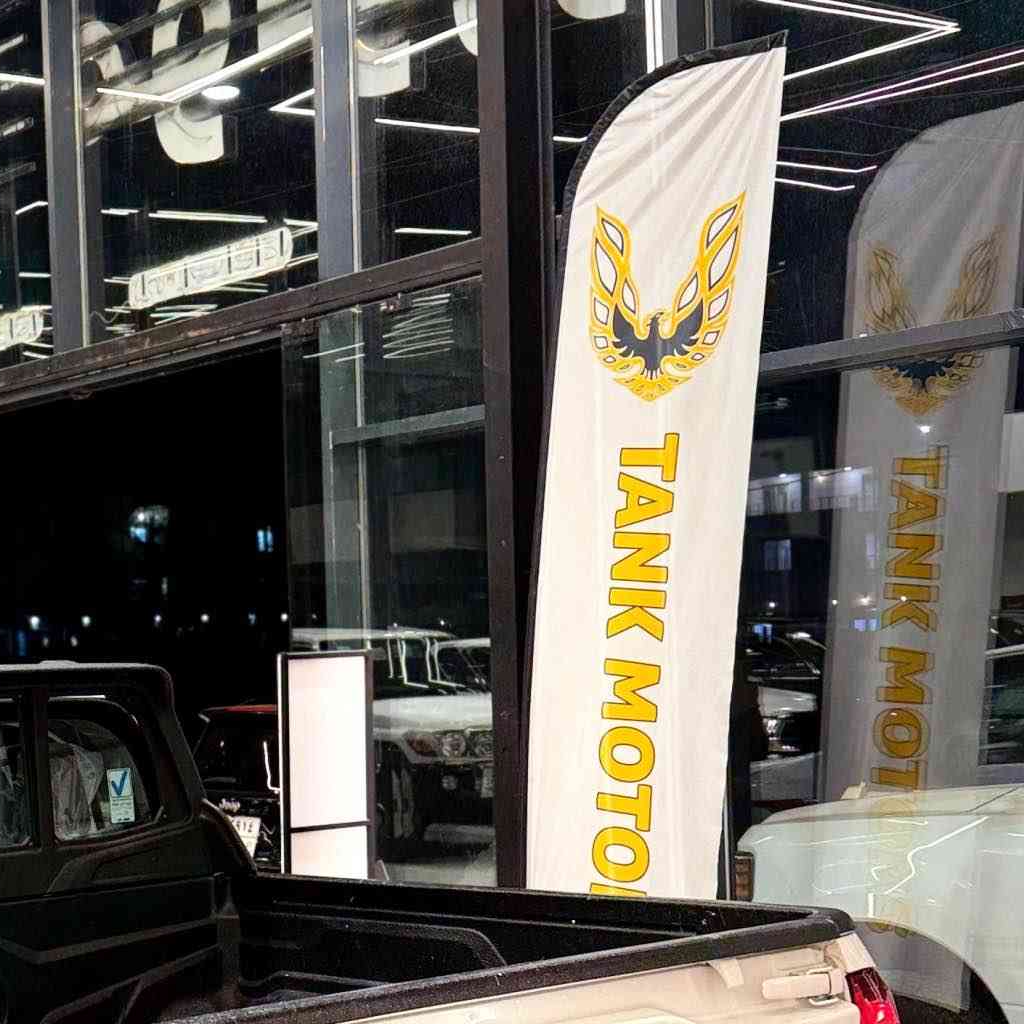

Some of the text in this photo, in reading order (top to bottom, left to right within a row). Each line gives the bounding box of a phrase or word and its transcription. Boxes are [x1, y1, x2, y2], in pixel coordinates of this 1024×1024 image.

[590, 432, 679, 896] TANK MOTO
[879, 445, 949, 634] TANK
